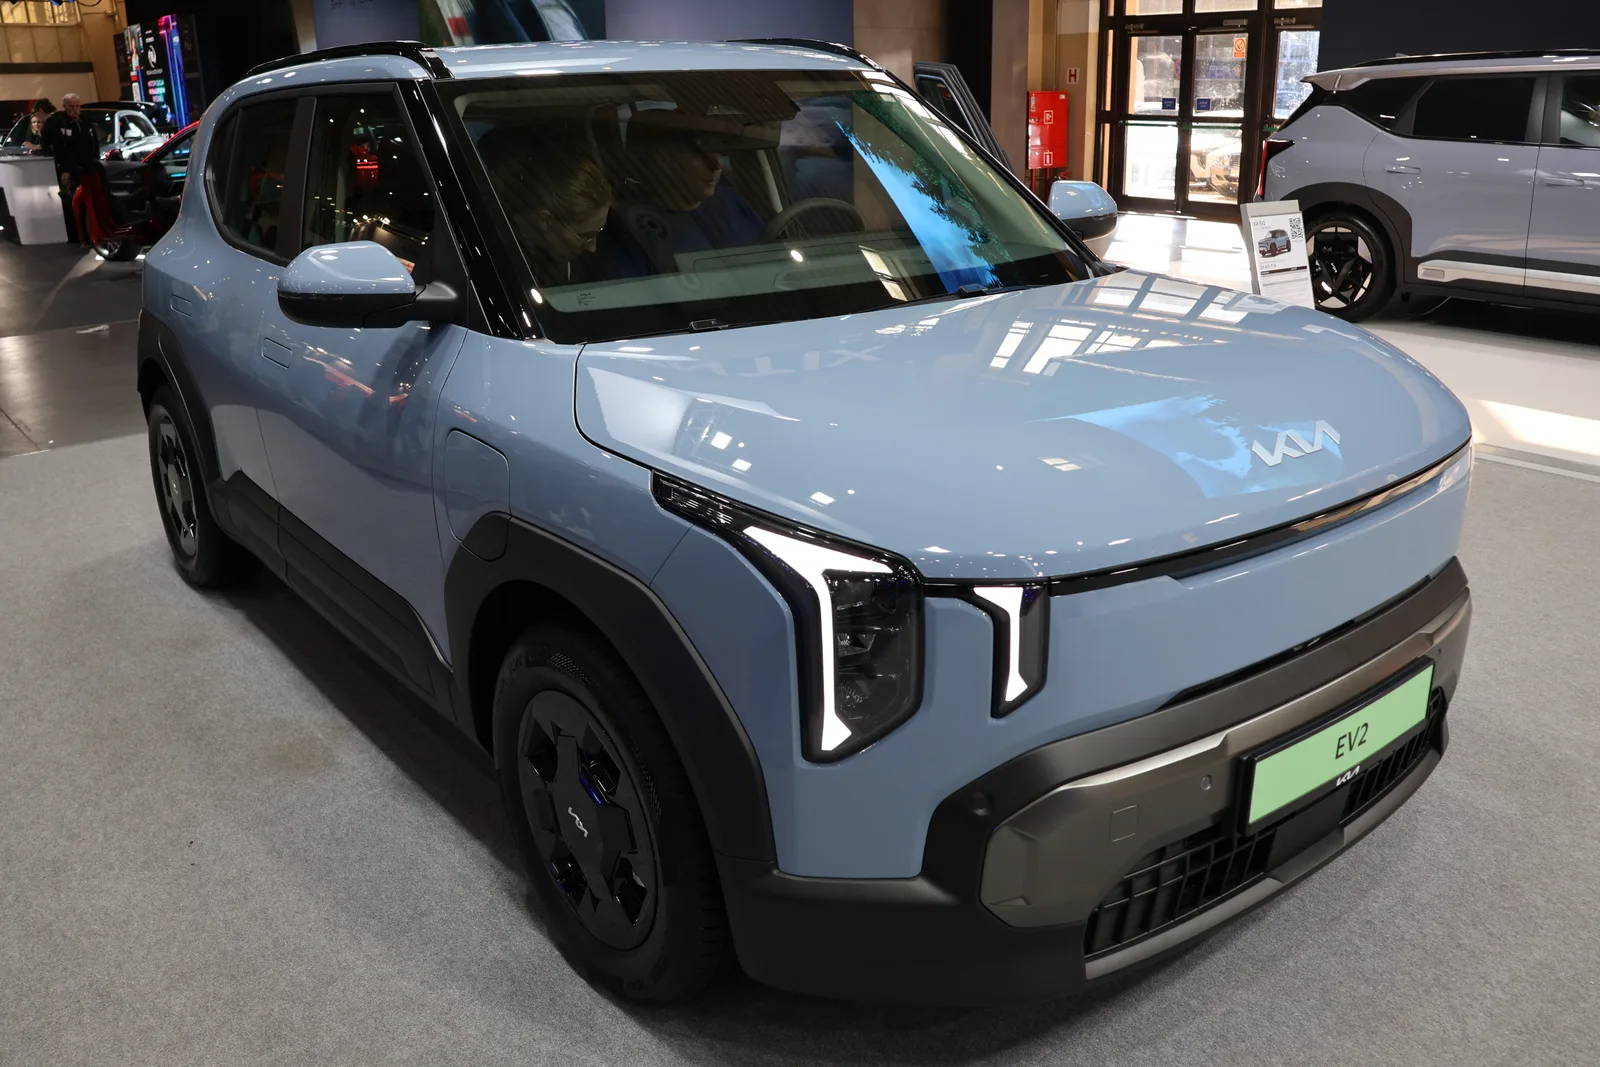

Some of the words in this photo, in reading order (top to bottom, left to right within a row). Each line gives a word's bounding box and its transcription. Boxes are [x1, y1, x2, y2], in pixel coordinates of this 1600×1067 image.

[1069, 69, 1077, 83] H
[1252, 420, 1341, 466] KIA
[1335, 723, 1369, 760] EV2
[1336, 765, 1361, 787] KIA
